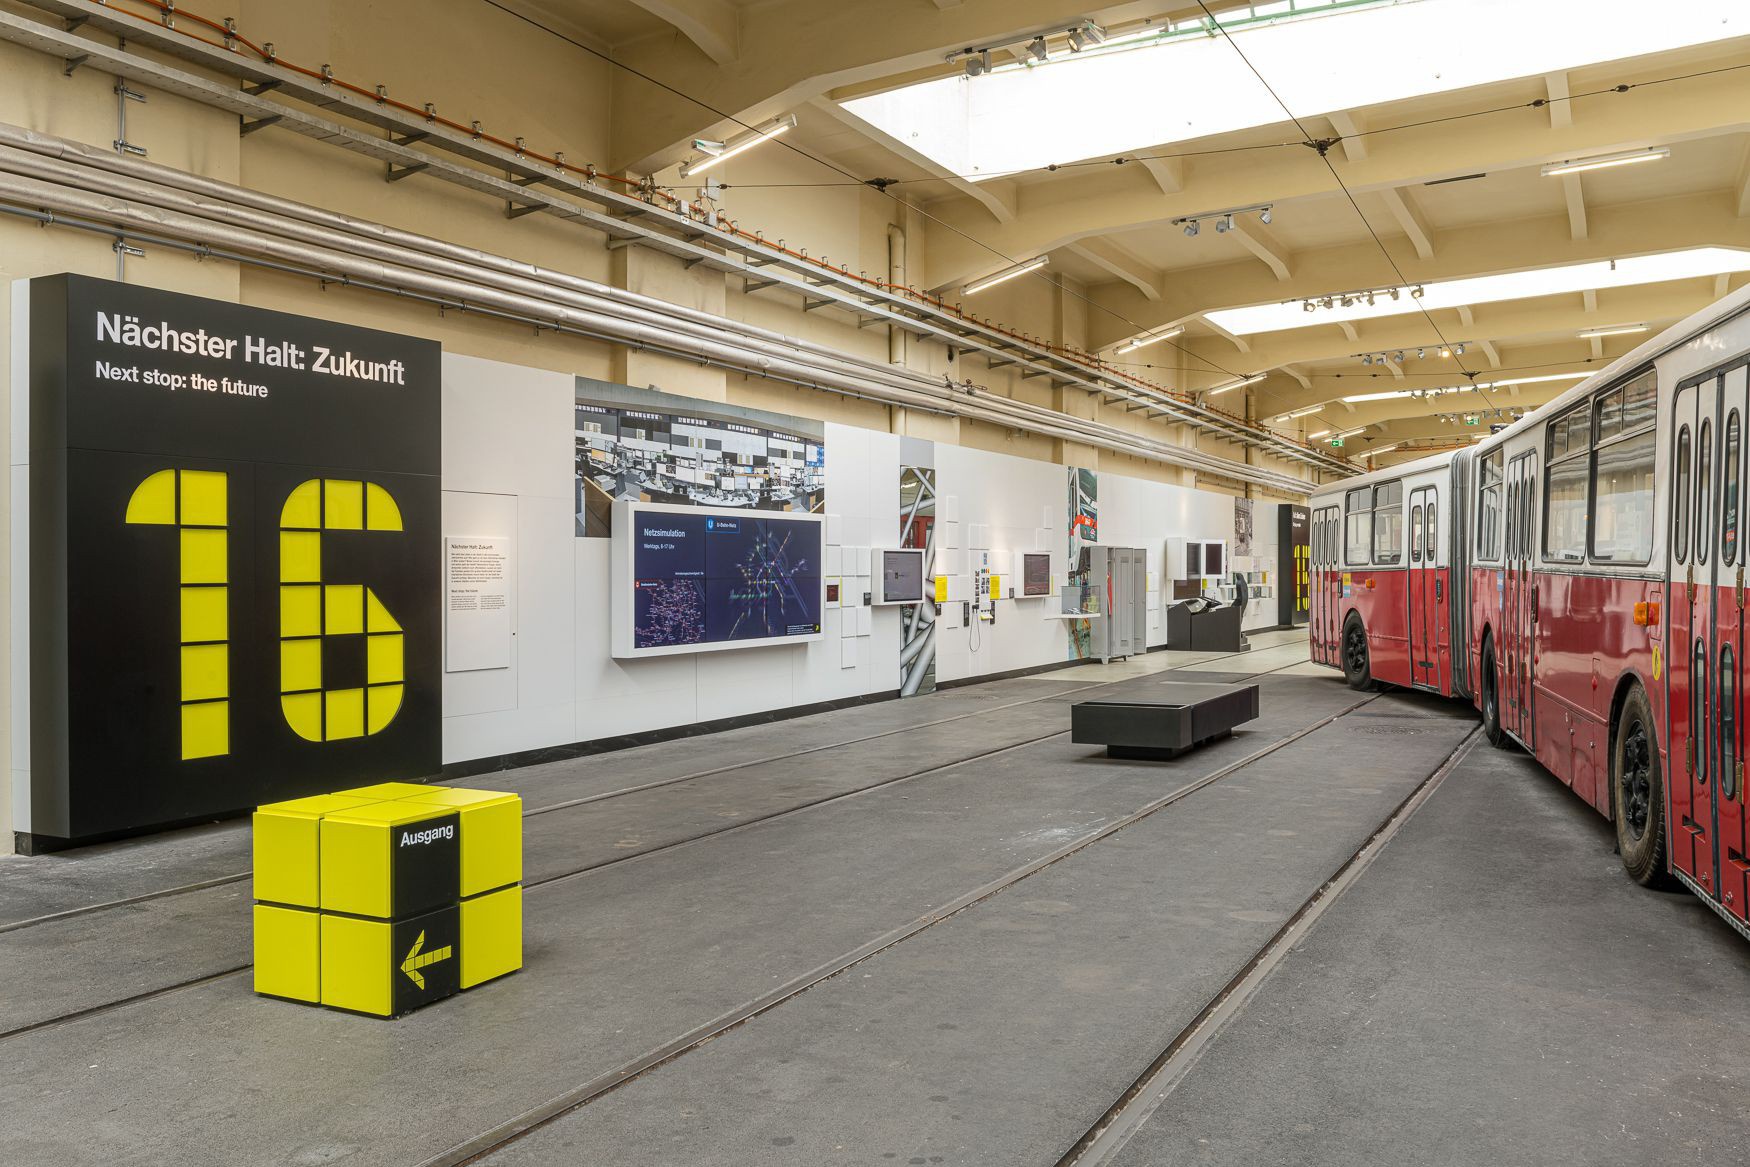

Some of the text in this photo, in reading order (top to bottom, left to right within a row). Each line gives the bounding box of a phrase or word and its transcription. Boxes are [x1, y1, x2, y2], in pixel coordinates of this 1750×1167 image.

[96, 311, 405, 386] Nächster Halt: Zukunft
[95, 360, 269, 398] Next stop: the future
[643, 528, 686, 537] Netzsimulation
[125, 468, 405, 760] 16
[400, 825, 454, 847] Ausgang
